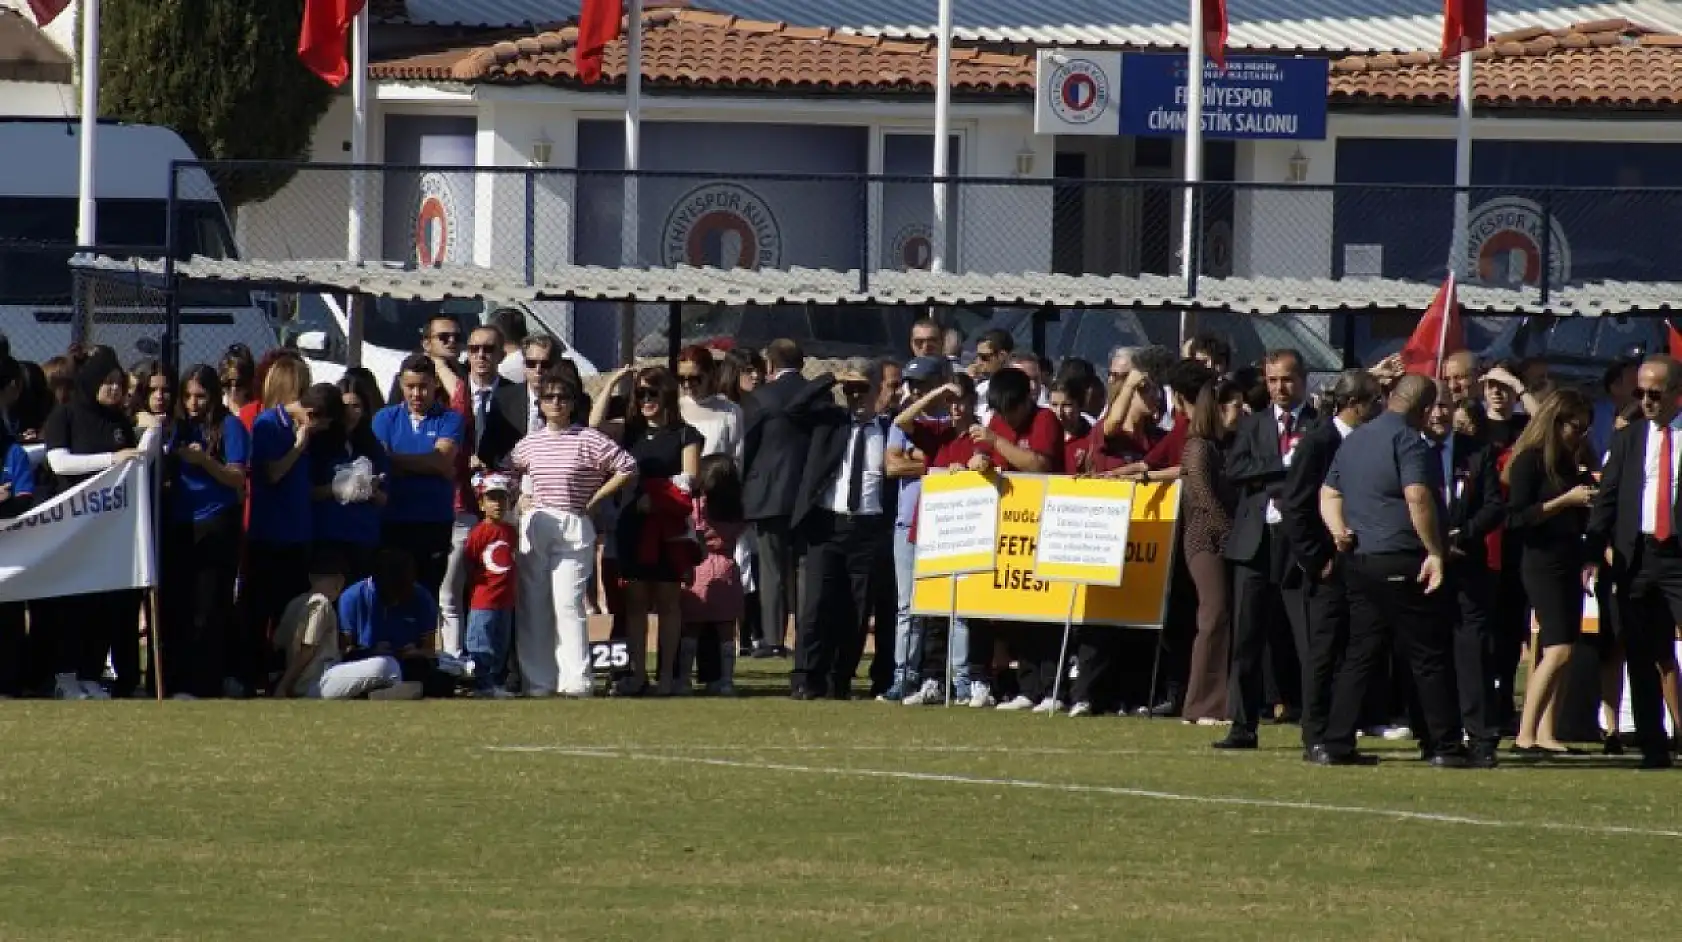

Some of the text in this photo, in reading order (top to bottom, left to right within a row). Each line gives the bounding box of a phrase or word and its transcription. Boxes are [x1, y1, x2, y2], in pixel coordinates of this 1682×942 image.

[1174, 82, 1273, 108] FEHİYESPOR
[1235, 113, 1298, 133] SALONU
[1003, 508, 1039, 523] MUĞL
[592, 643, 630, 667] 25
